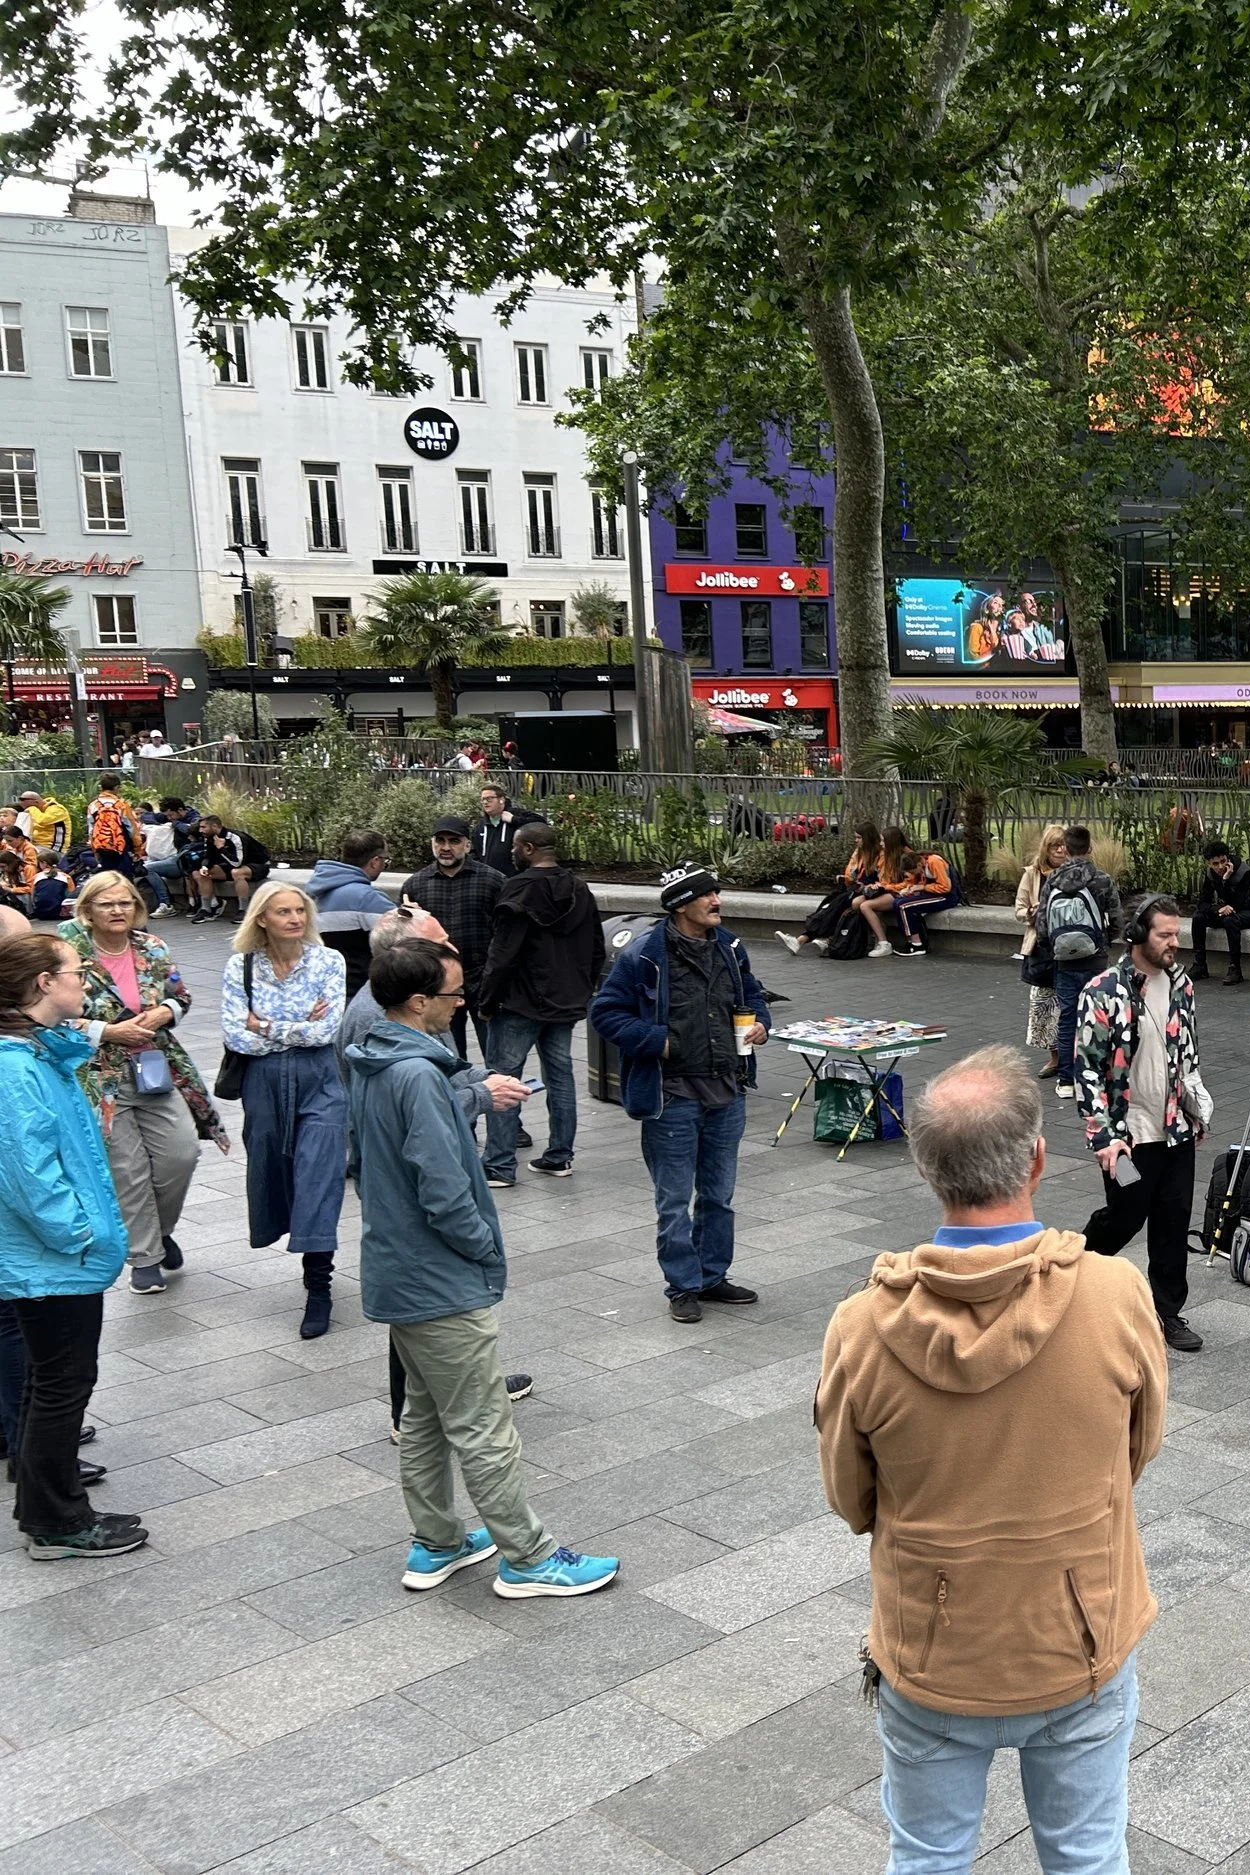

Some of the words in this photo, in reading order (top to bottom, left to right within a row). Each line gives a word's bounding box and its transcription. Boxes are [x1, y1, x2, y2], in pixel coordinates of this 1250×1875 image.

[409, 420, 454, 440] SALT
[1, 551, 76, 577] Pizza
[82, 552, 144, 577] Hut
[695, 571, 758, 588] Jollibee
[707, 688, 770, 704] Jollibee
[975, 690, 1008, 700] BOOK
[1011, 690, 1038, 700] NOW
